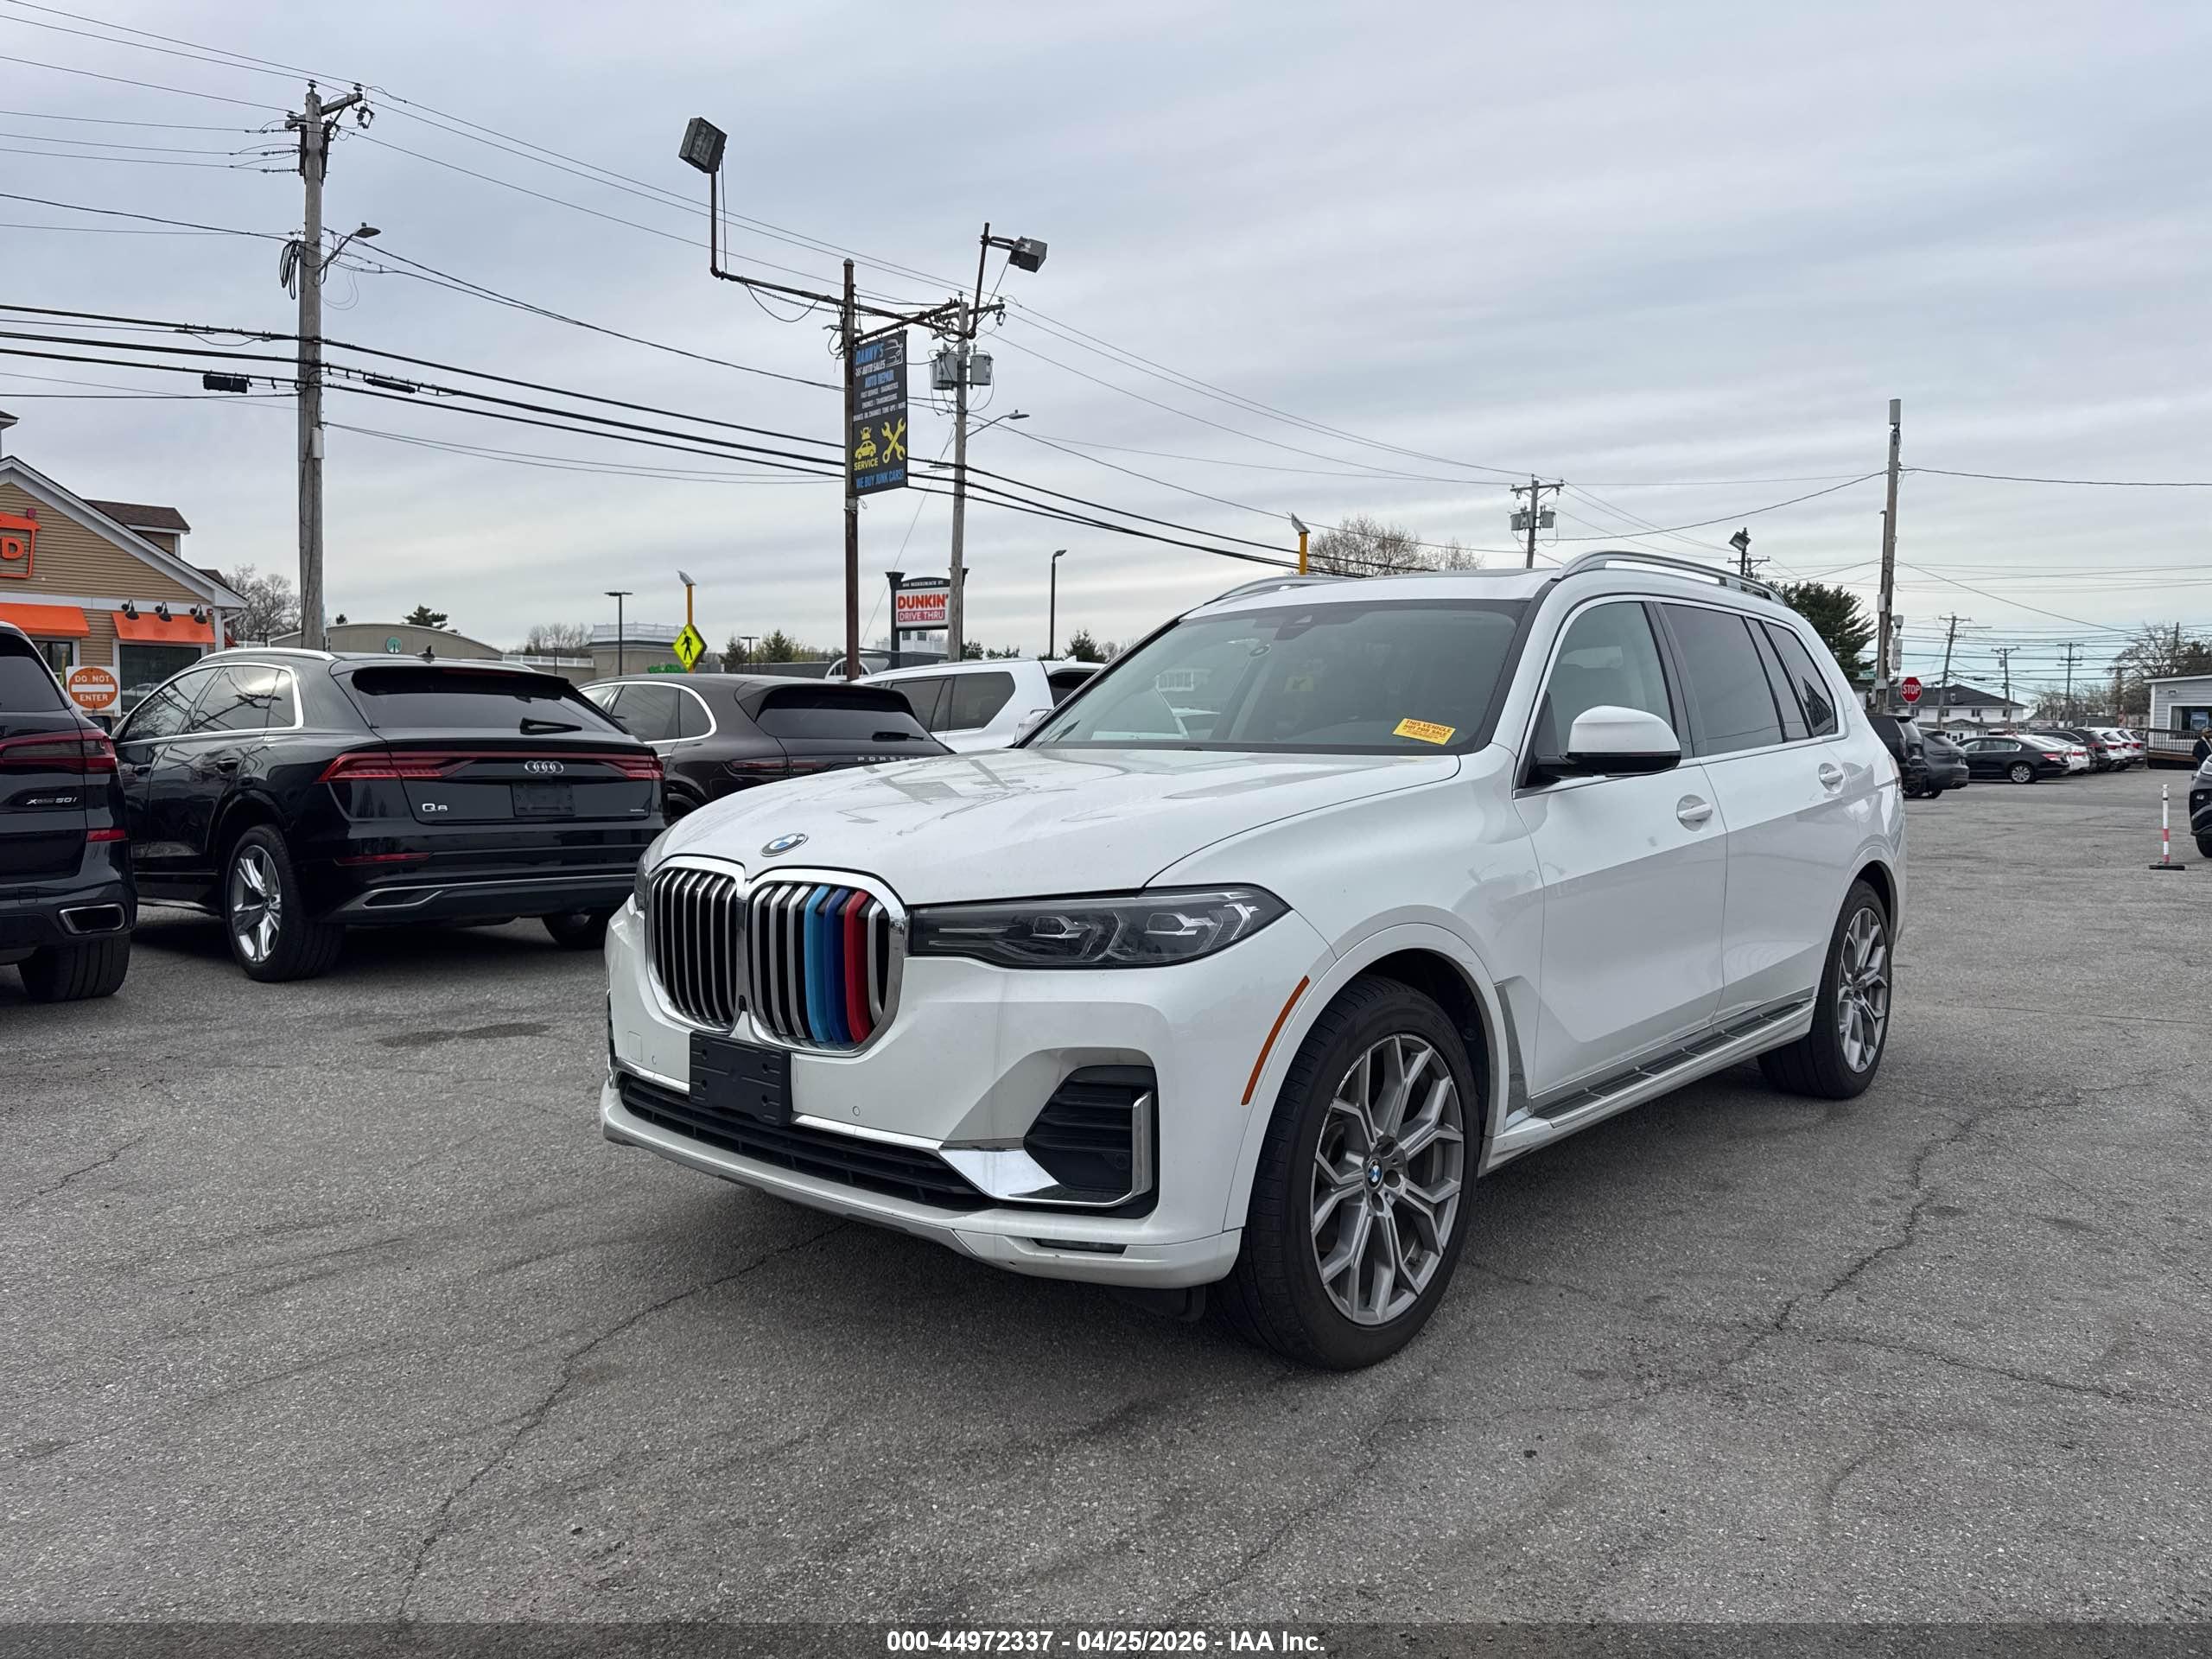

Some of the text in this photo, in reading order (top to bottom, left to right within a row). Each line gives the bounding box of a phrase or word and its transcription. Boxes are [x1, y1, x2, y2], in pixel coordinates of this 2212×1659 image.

[856, 342, 885, 365] DANNY'S
[862, 359, 886, 375] AUTO SALES
[854, 458, 879, 471] SERVICE
[856, 477, 864, 489] WE
[864, 474, 874, 487] BUY
[876, 471, 888, 485] JUNK
[898, 594, 949, 609] DUNKIN'
[899, 610, 944, 621] DRIVE THRU
[1903, 684, 1921, 695] STOP
[79, 693, 109, 702] ENTER
[1423, 723, 1452, 733] VEHICLE
